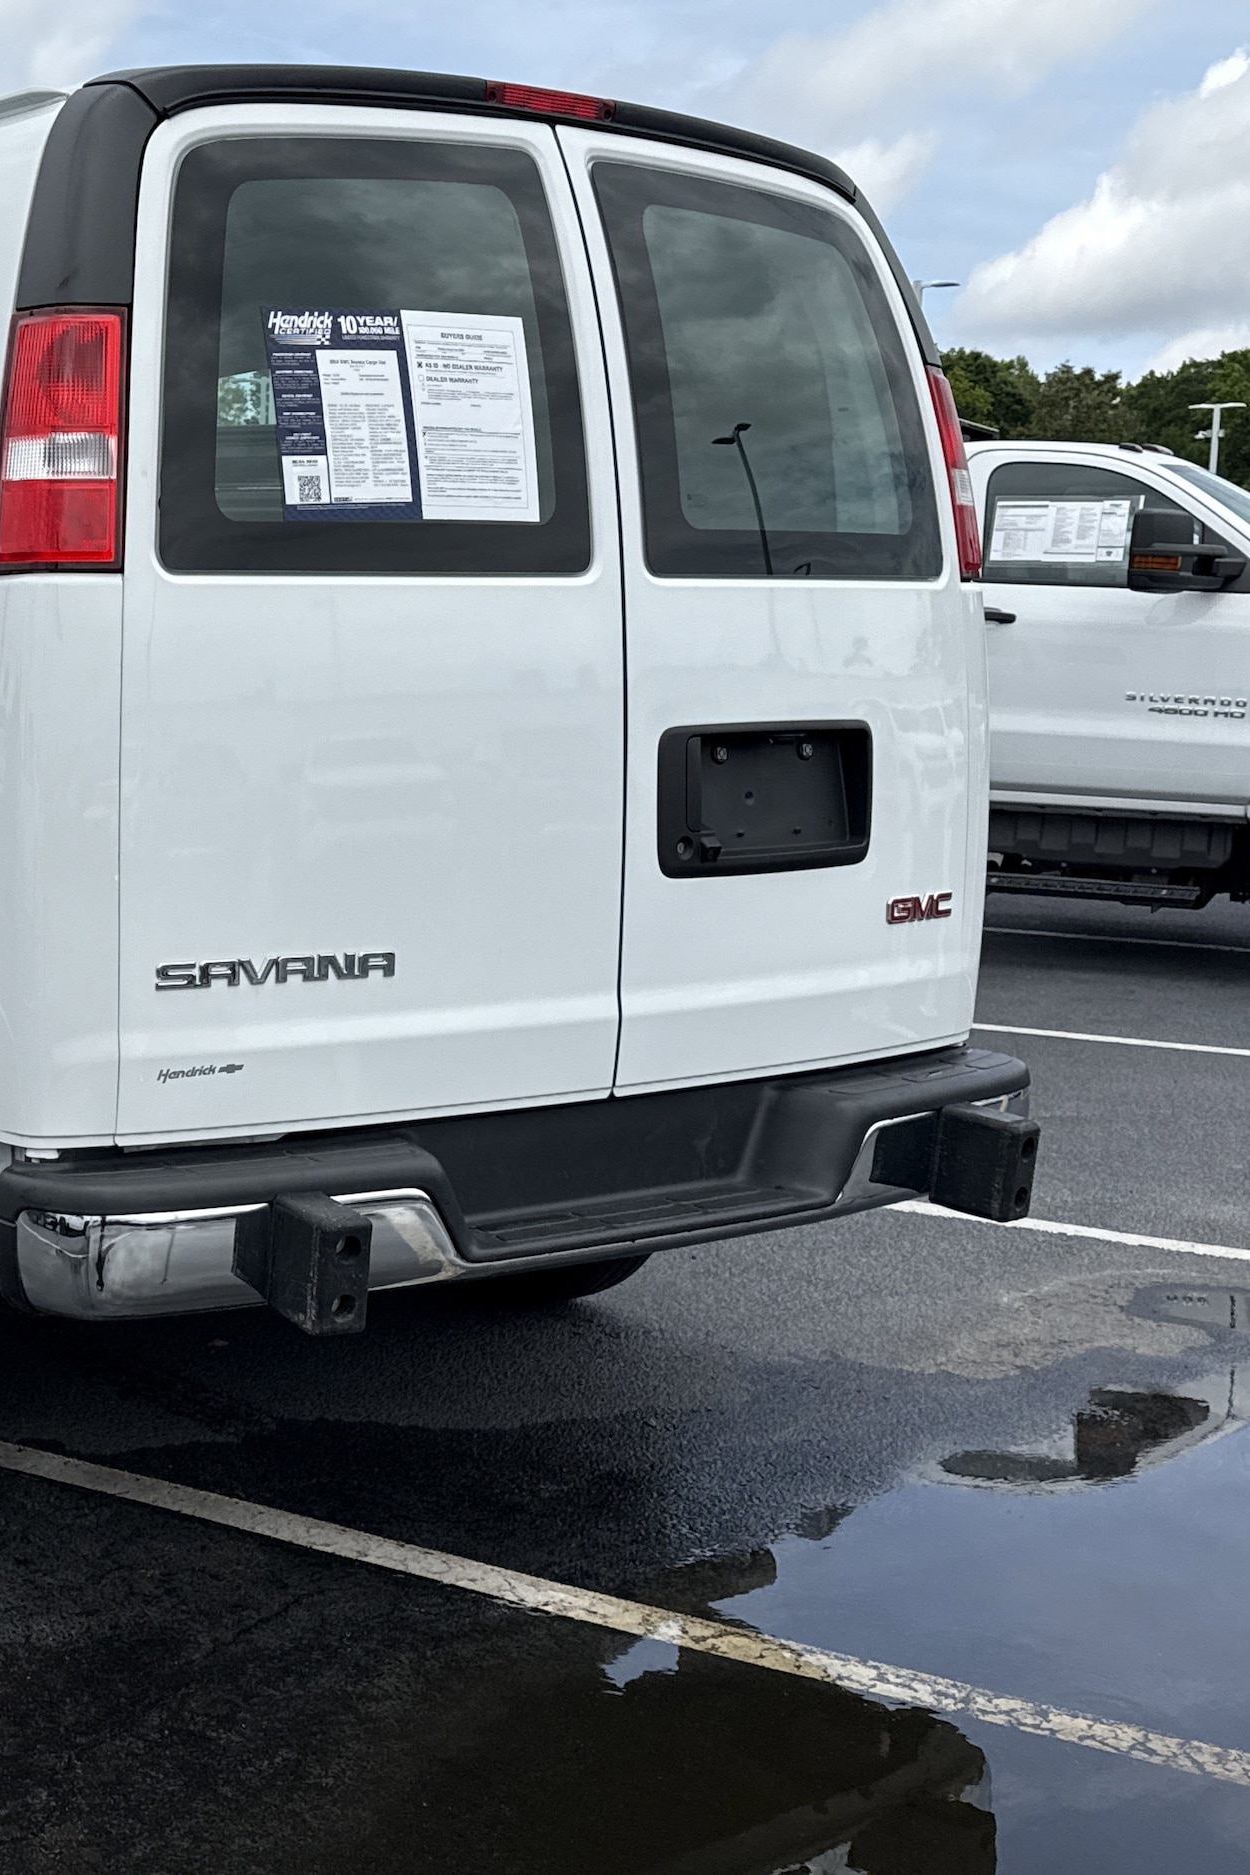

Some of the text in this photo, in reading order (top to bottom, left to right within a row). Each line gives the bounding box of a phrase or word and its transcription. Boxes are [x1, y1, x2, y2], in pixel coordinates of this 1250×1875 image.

[267, 310, 333, 335] Hendrick
[279, 327, 332, 335] CERTIFIED
[337, 315, 398, 335] 10 YEAR/
[440, 332, 483, 341] BUYERS GUIDE
[474, 365, 503, 373] WARRANTY
[1125, 691, 1248, 708] SILVERADO
[1147, 704, 1247, 719] 4500 HD
[886, 890, 953, 925] GMC
[155, 951, 396, 991] SAVANA
[156, 1064, 218, 1084] Hendrick
